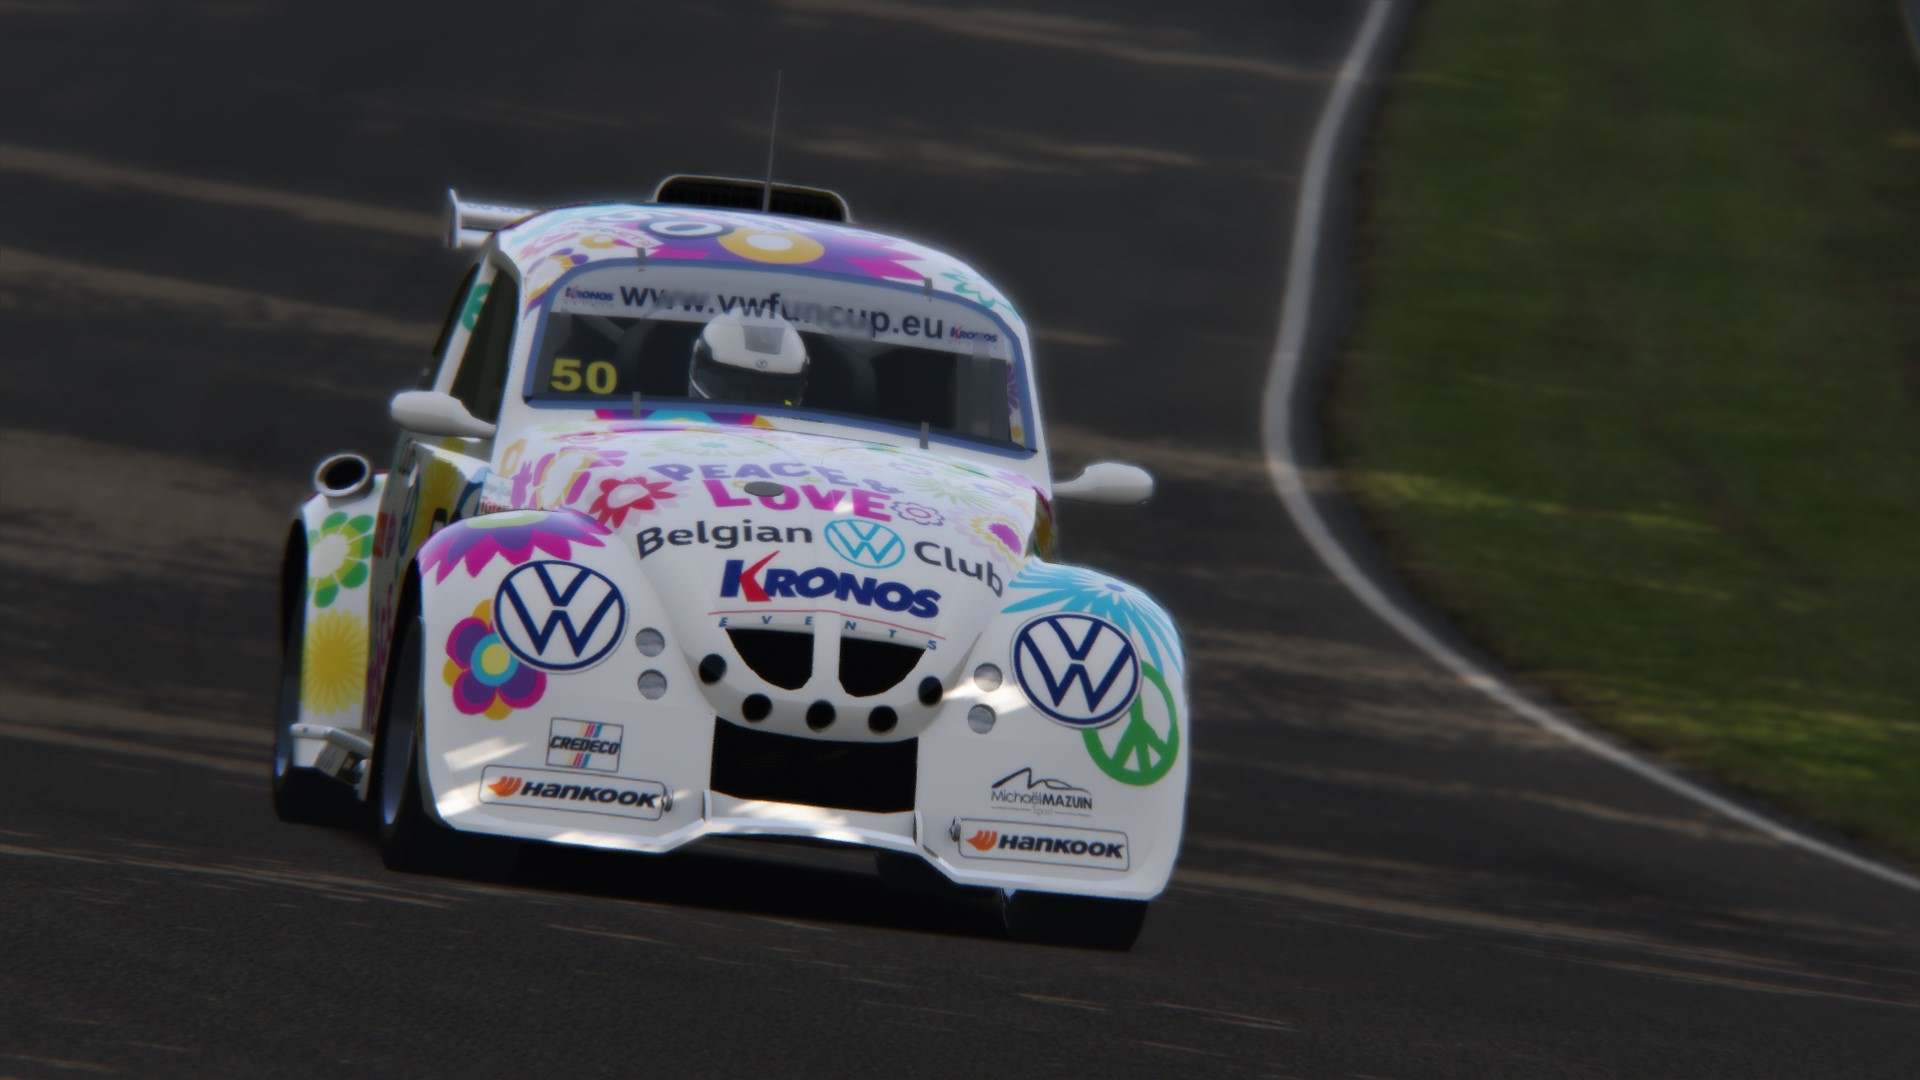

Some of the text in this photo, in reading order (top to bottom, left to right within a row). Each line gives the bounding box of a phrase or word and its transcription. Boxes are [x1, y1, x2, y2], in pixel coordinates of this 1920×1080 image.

[619, 286, 943, 339] www.vwfuncup.eu
[551, 358, 617, 394] 50
[650, 462, 859, 488] PEACE
[703, 480, 892, 522] LOVE
[636, 521, 813, 560] Belgian
[914, 541, 1003, 598] Club
[720, 550, 942, 618] KRONOS
[549, 736, 621, 756] CREDECO
